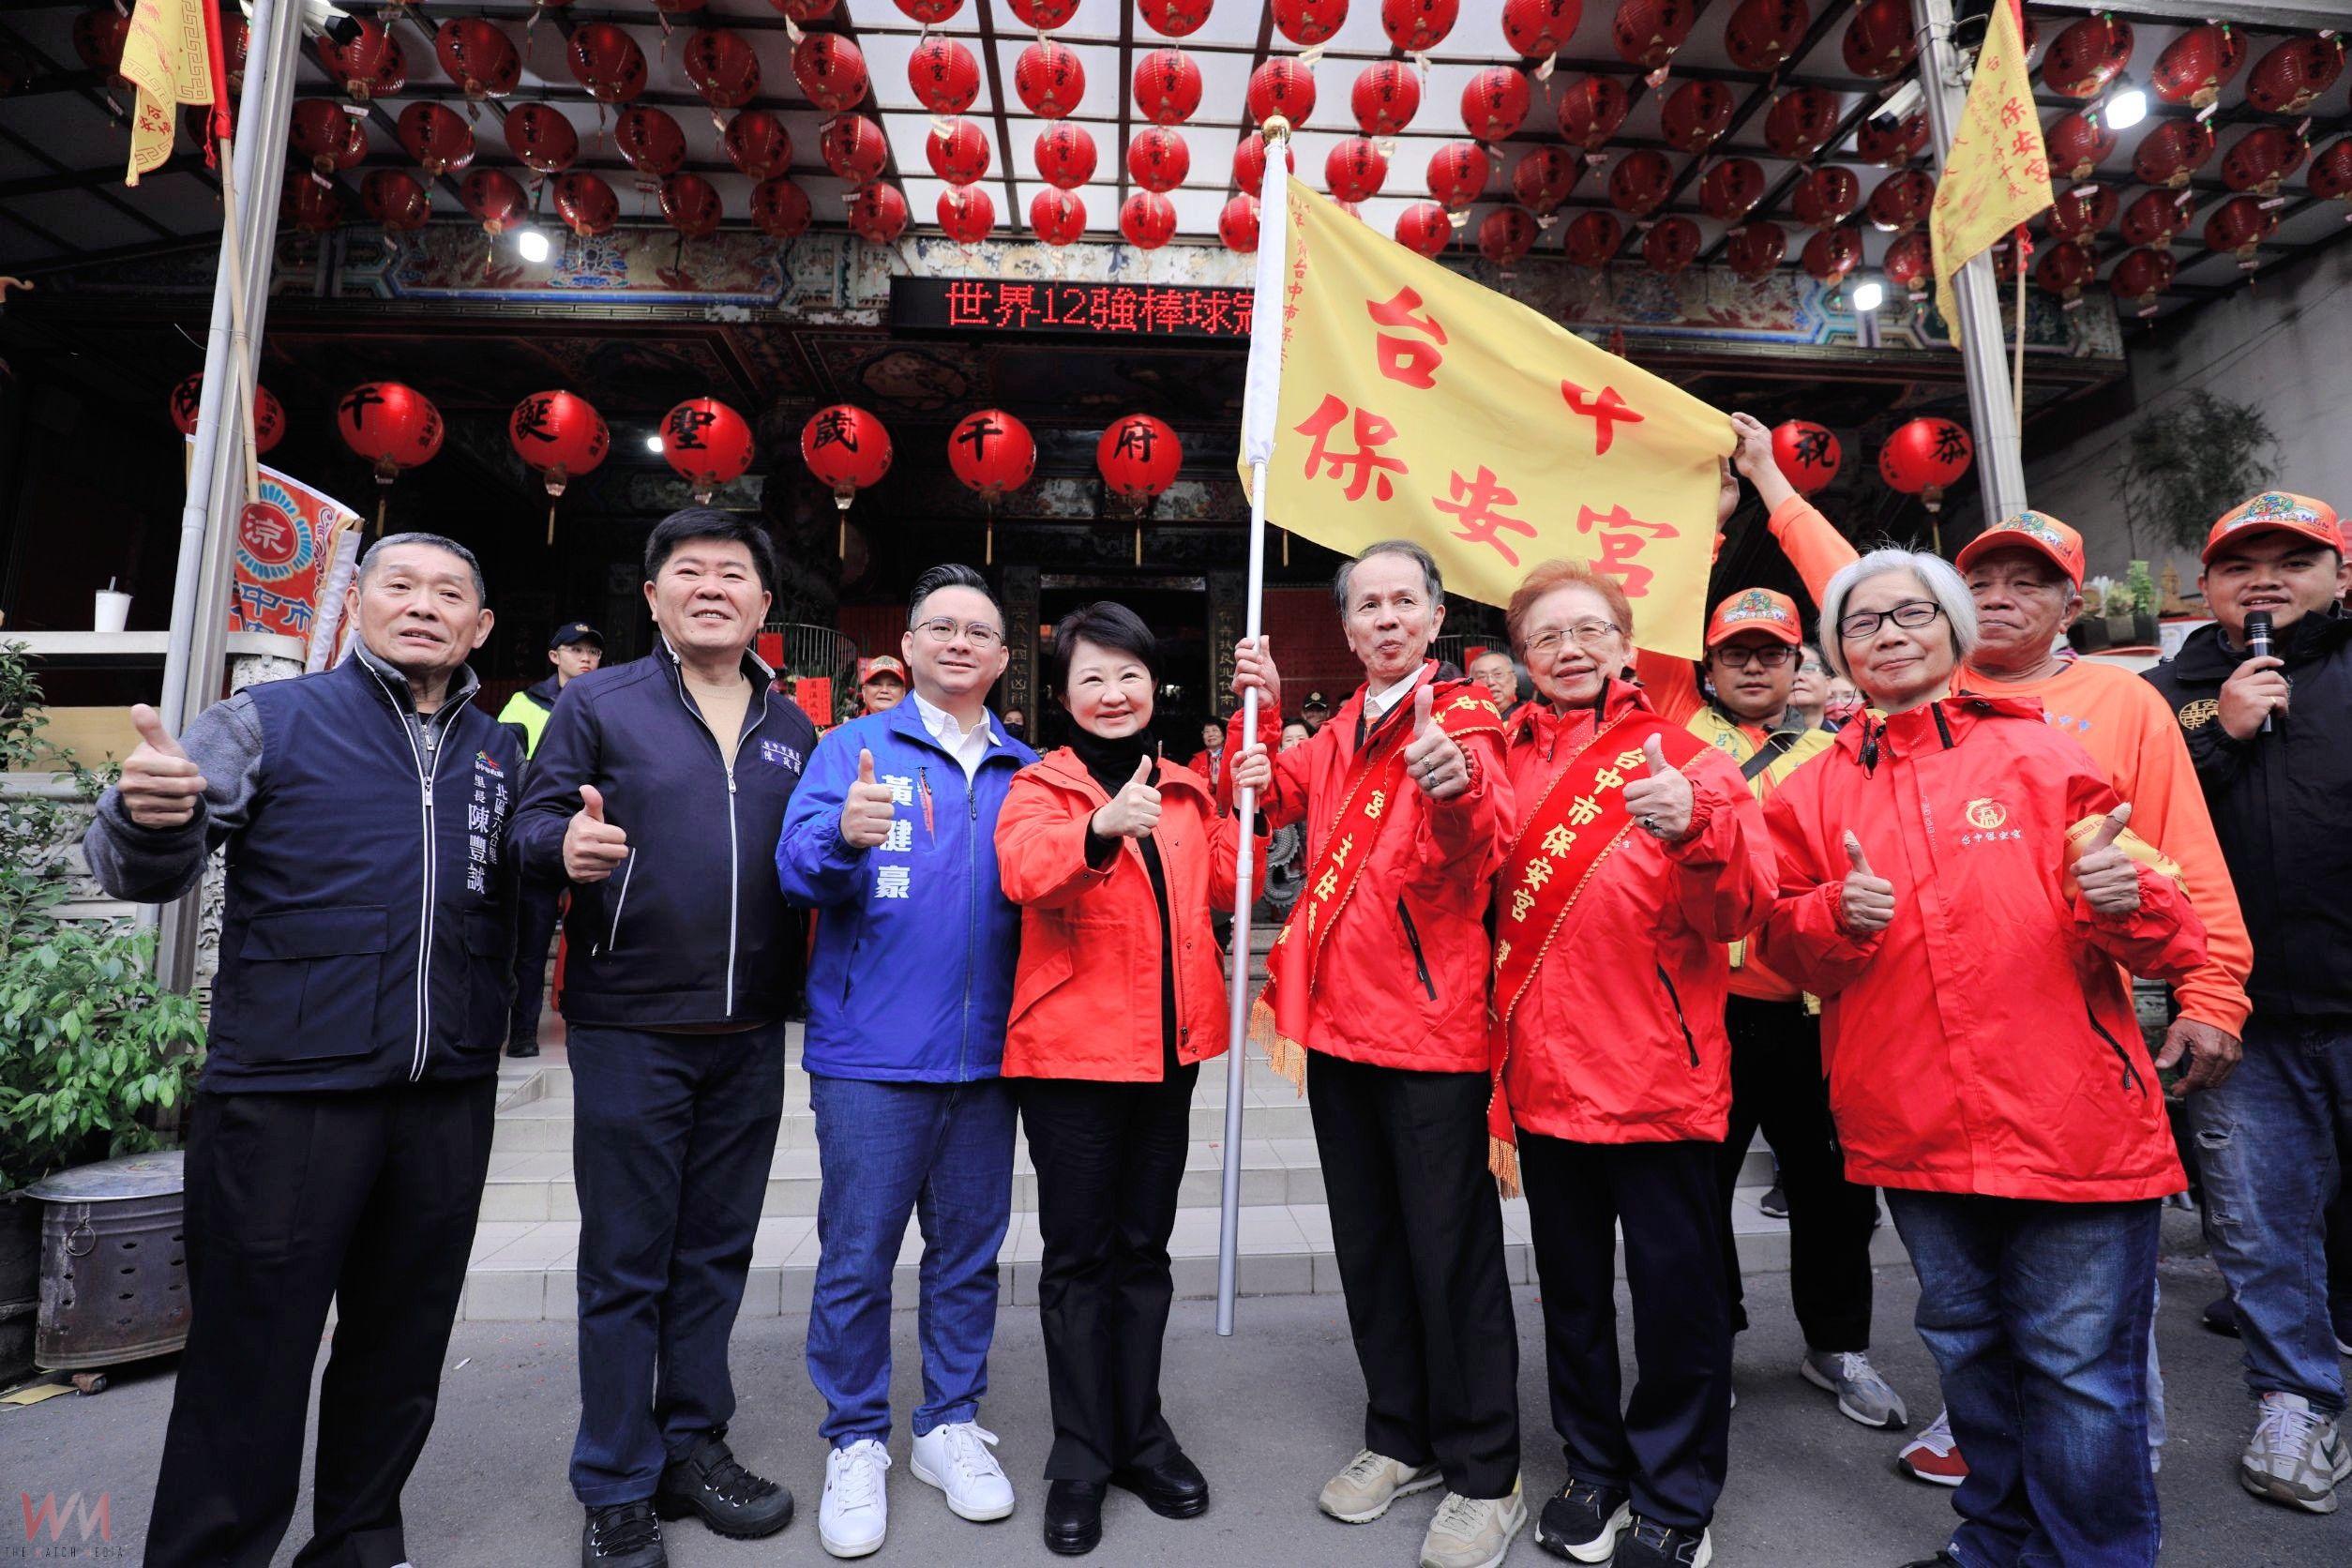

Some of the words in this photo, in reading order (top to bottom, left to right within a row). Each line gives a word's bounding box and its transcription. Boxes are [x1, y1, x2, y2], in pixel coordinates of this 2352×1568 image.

[515, 398, 558, 444] 誕
[668, 406, 716, 451] 聖
[813, 411, 859, 454] 歲
[957, 417, 1003, 463] 千
[1112, 422, 1159, 466] 府
[1793, 429, 1835, 470] 祝
[1929, 427, 1968, 465] 恭
[1510, 746, 1647, 923] 台中市保安宮
